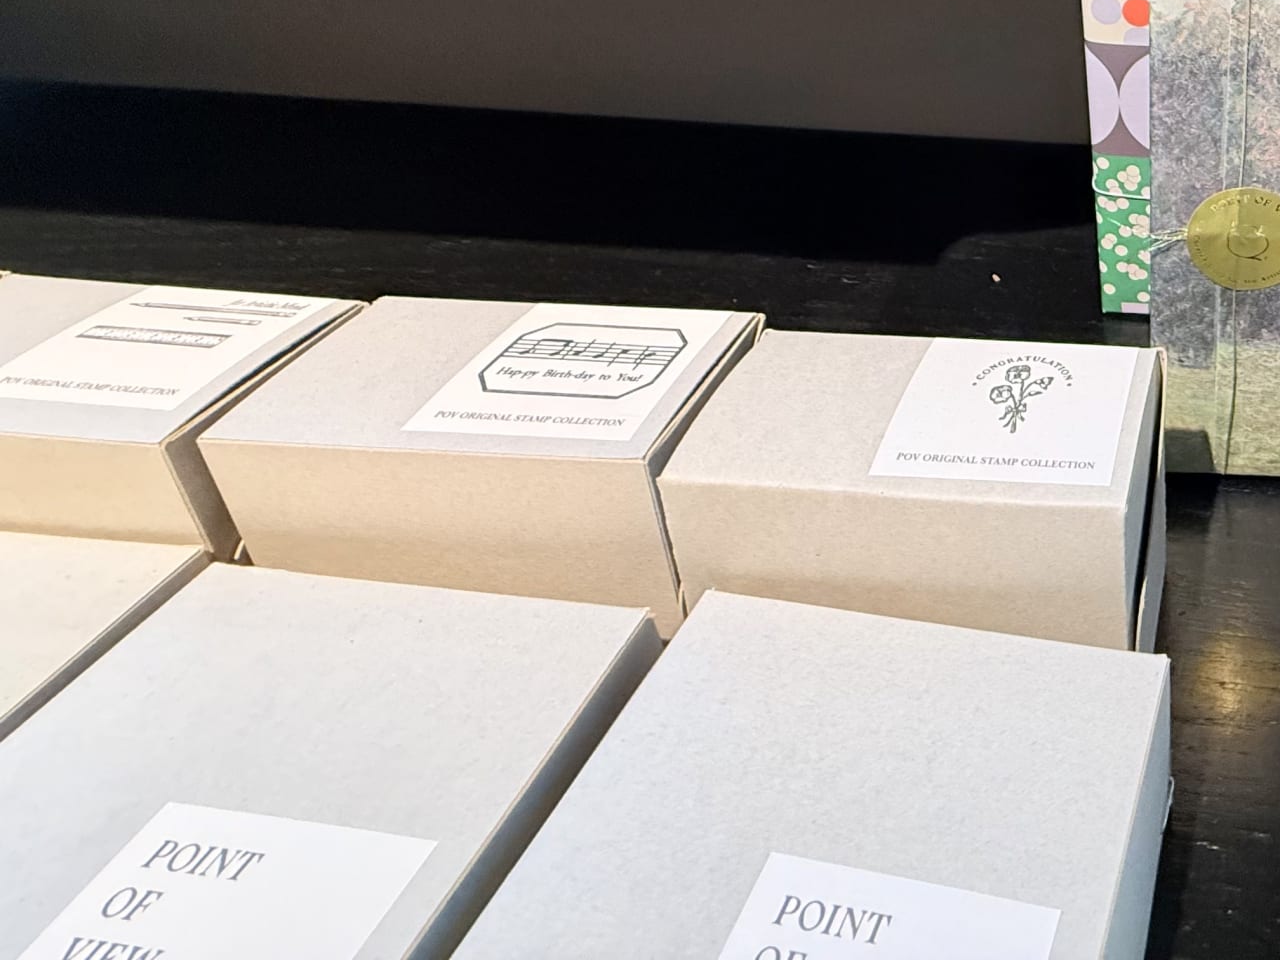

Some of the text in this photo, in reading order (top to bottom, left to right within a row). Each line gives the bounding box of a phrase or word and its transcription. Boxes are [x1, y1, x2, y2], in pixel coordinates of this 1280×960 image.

[1254, 196, 1272, 207] OF
[598, 372, 611, 381] to
[616, 373, 645, 383] You!
[975, 355, 1074, 382] CONGRATULATION
[74, 382, 113, 391] STAMP
[109, 384, 181, 396] COLLECTION
[434, 410, 627, 427] POV ORIGINAL STAMP COLLECTION
[896, 452, 1096, 471] POV ORIGINAL STAMP COLLECTION
[141, 839, 266, 881] POINT
[100, 886, 164, 921] OF
[772, 895, 893, 945] POINT
